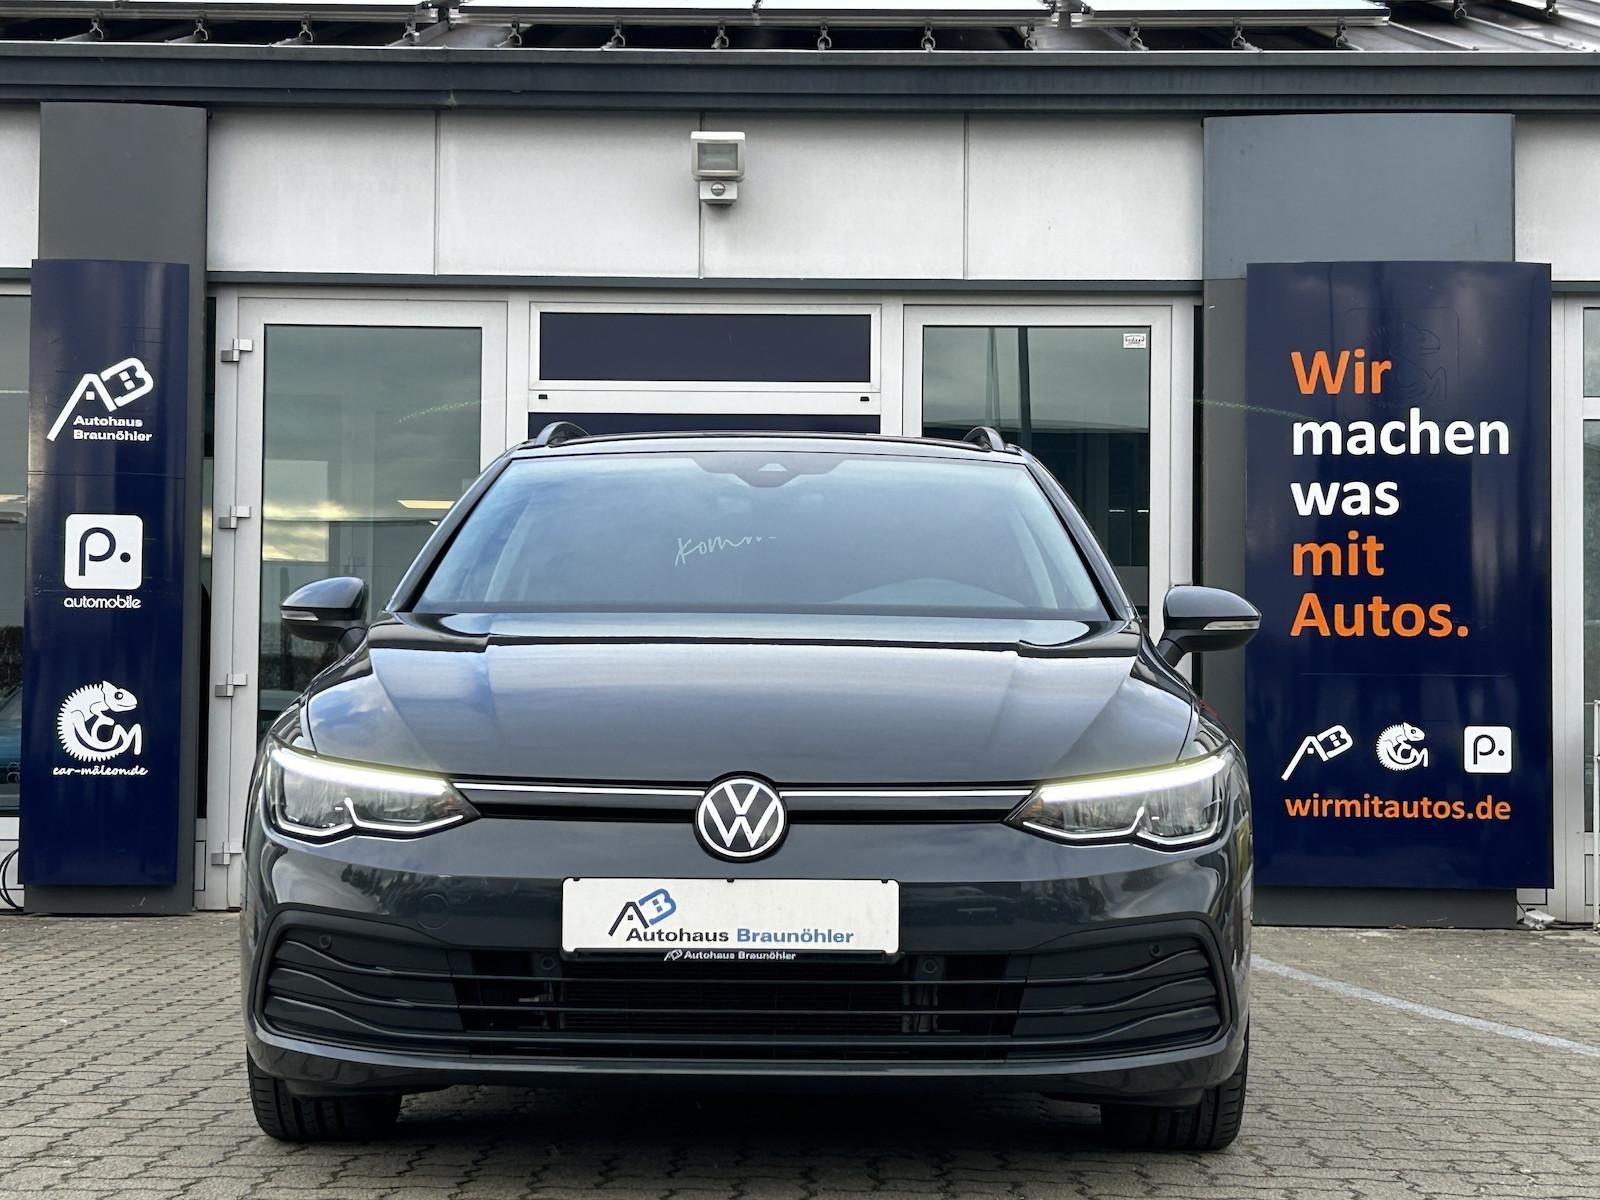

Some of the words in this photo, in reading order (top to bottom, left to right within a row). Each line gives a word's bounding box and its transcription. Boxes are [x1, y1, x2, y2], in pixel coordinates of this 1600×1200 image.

[1291, 348, 1392, 395] Wir
[73, 415, 143, 428] Autohaus
[1293, 407, 1510, 455] machen
[73, 430, 153, 442] Braunöhler
[1290, 481, 1400, 516] was
[1293, 530, 1385, 577] mit
[63, 594, 142, 609] automobile
[1290, 592, 1469, 638] Autos.
[1285, 793, 1511, 820] wirmitautos.de
[625, 928, 729, 943] Autohaus
[737, 928, 854, 943] Braunöhler
[684, 950, 735, 960] Autohaus
[738, 950, 796, 960] Braunöhler
